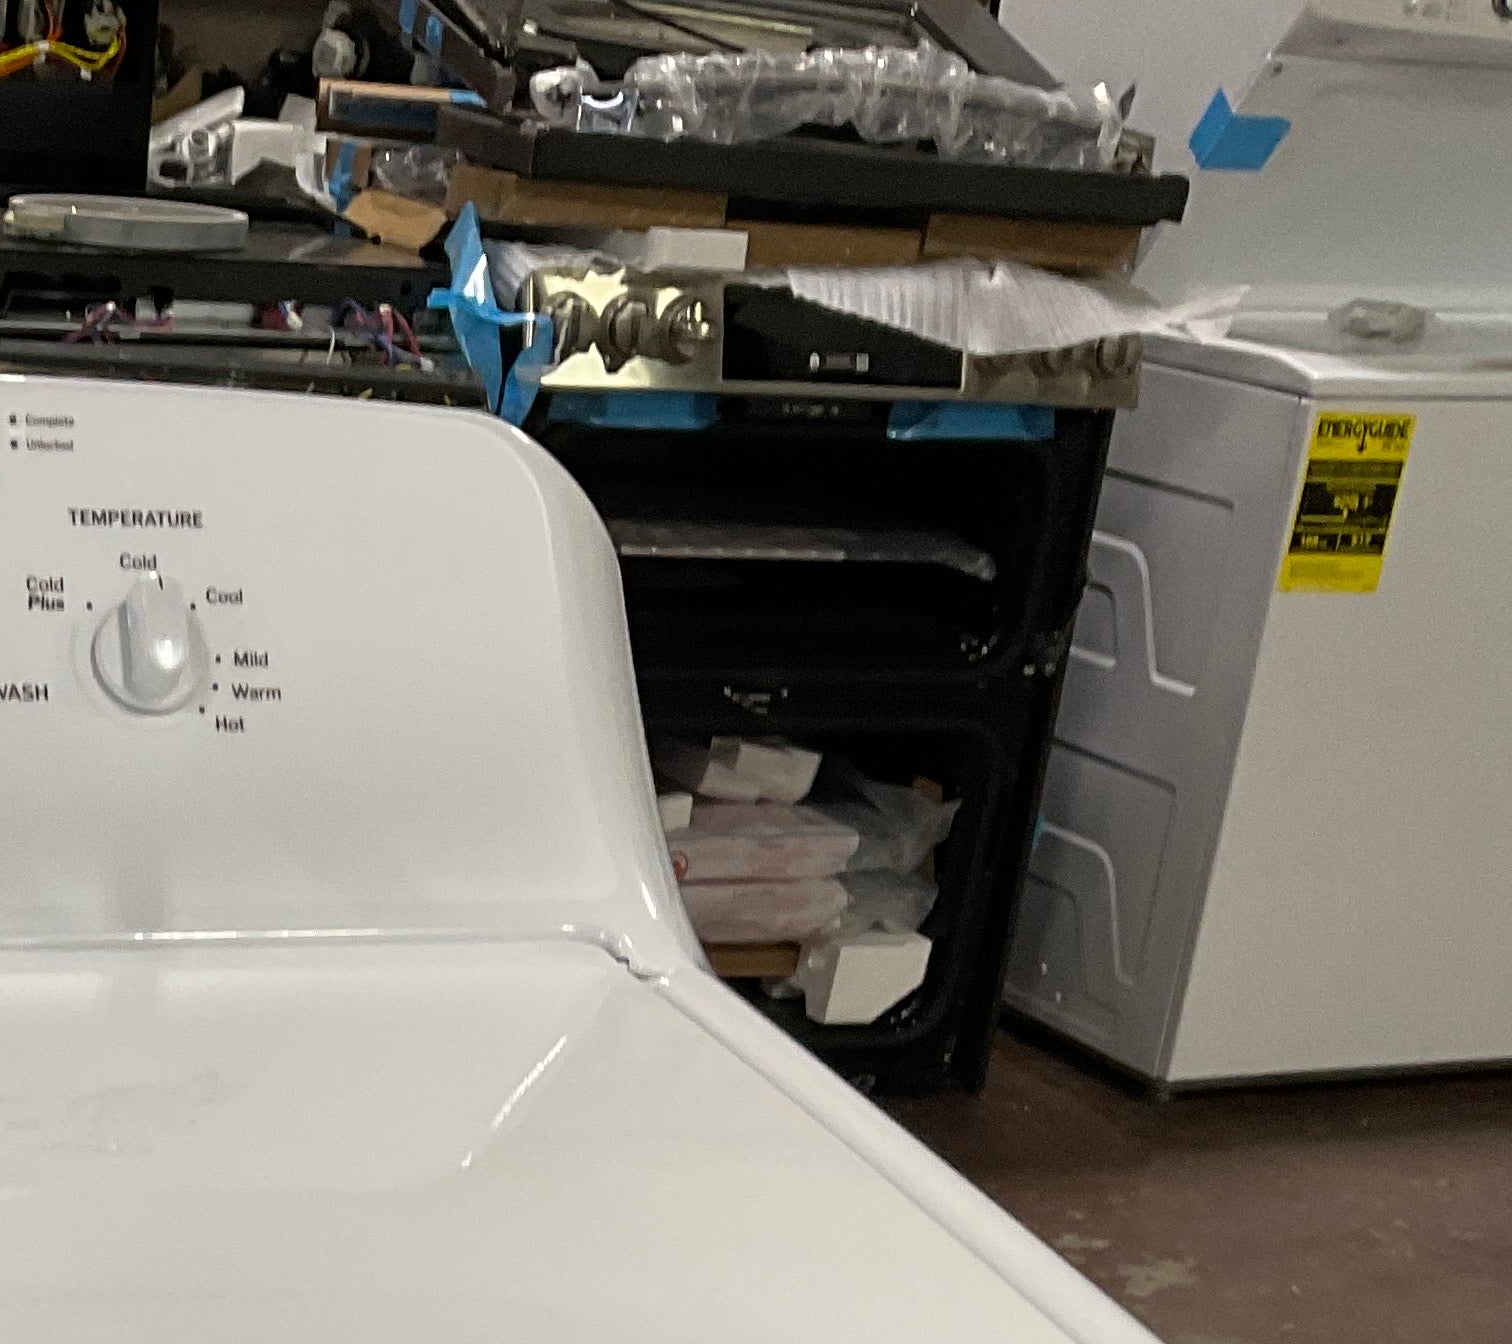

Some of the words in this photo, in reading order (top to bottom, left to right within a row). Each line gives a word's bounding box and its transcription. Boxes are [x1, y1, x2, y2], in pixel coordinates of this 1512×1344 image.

[69, 508, 202, 529] TEMPERATURE
[119, 553, 158, 571] Cold
[25, 576, 65, 594] Cold
[27, 593, 65, 611] Plus
[205, 587, 243, 605] Cool
[233, 650, 269, 668] Mild
[231, 683, 282, 701] Warm
[215, 716, 245, 732] Hot
